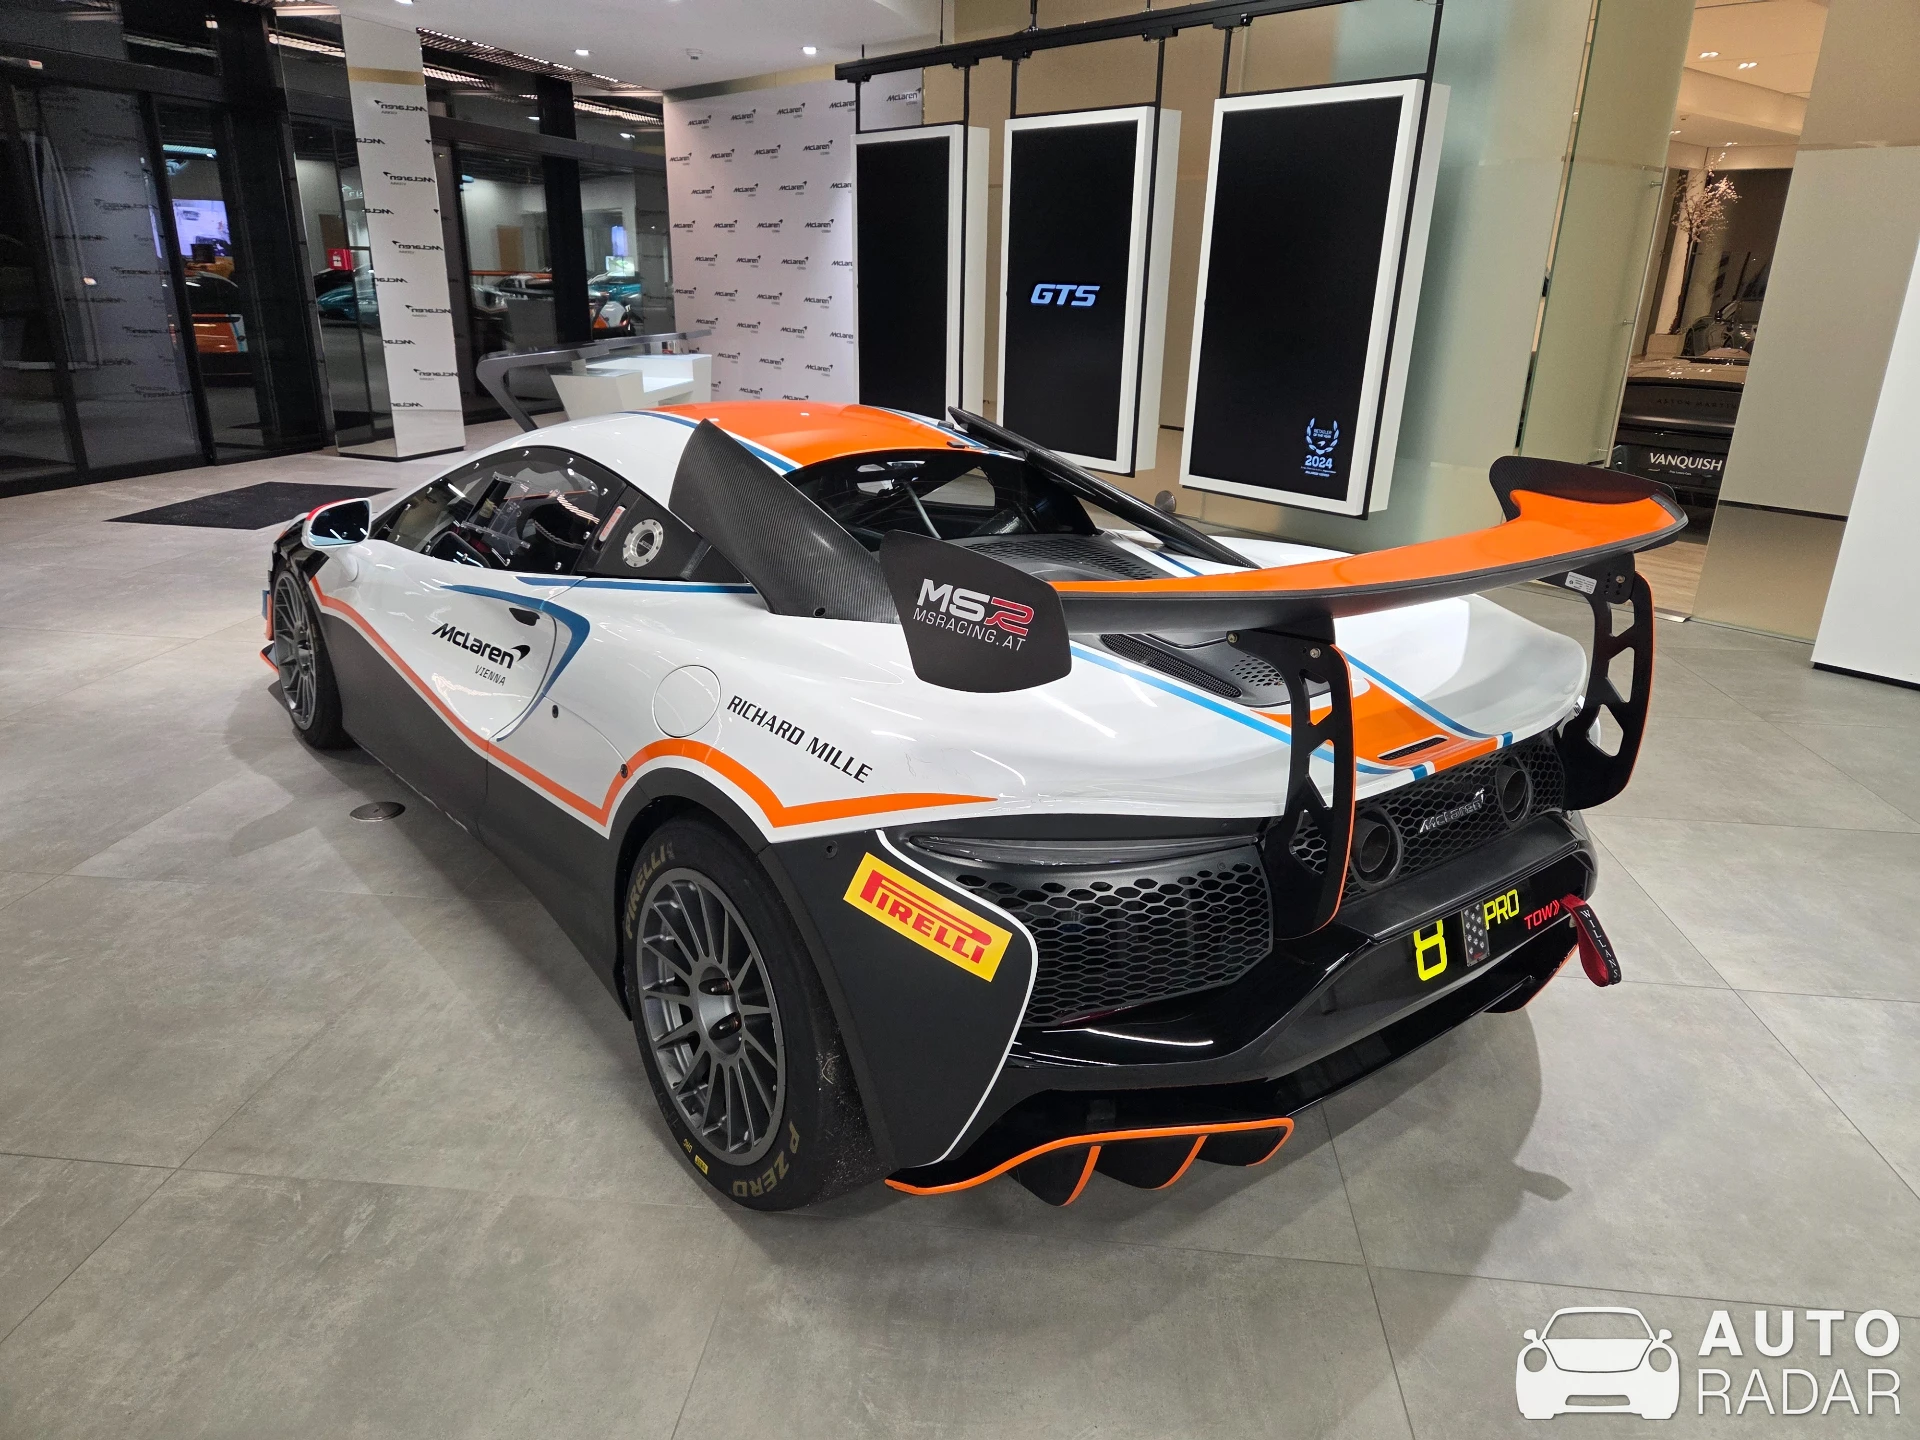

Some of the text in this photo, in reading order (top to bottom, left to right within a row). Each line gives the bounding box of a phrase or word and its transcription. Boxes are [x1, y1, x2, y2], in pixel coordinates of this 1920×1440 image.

[1031, 284, 1100, 307] GTS
[1305, 455, 1333, 469] 2024
[1649, 452, 1723, 471] VANQUISH
[913, 607, 1026, 651] MSRACING.AT
[916, 578, 1034, 636] MSR
[432, 623, 514, 669] McLaren
[475, 665, 506, 686] VIENNA
[727, 695, 873, 783] RICHARD MILLE
[1420, 800, 1482, 833] McLaren
[860, 869, 992, 964] PIRELLI
[1484, 889, 1520, 930] PRO
[1524, 903, 1553, 930] TOW
[1413, 919, 1447, 981] 8
[1580, 909, 1618, 978] WILLANS
[732, 1151, 789, 1197] ZERO
